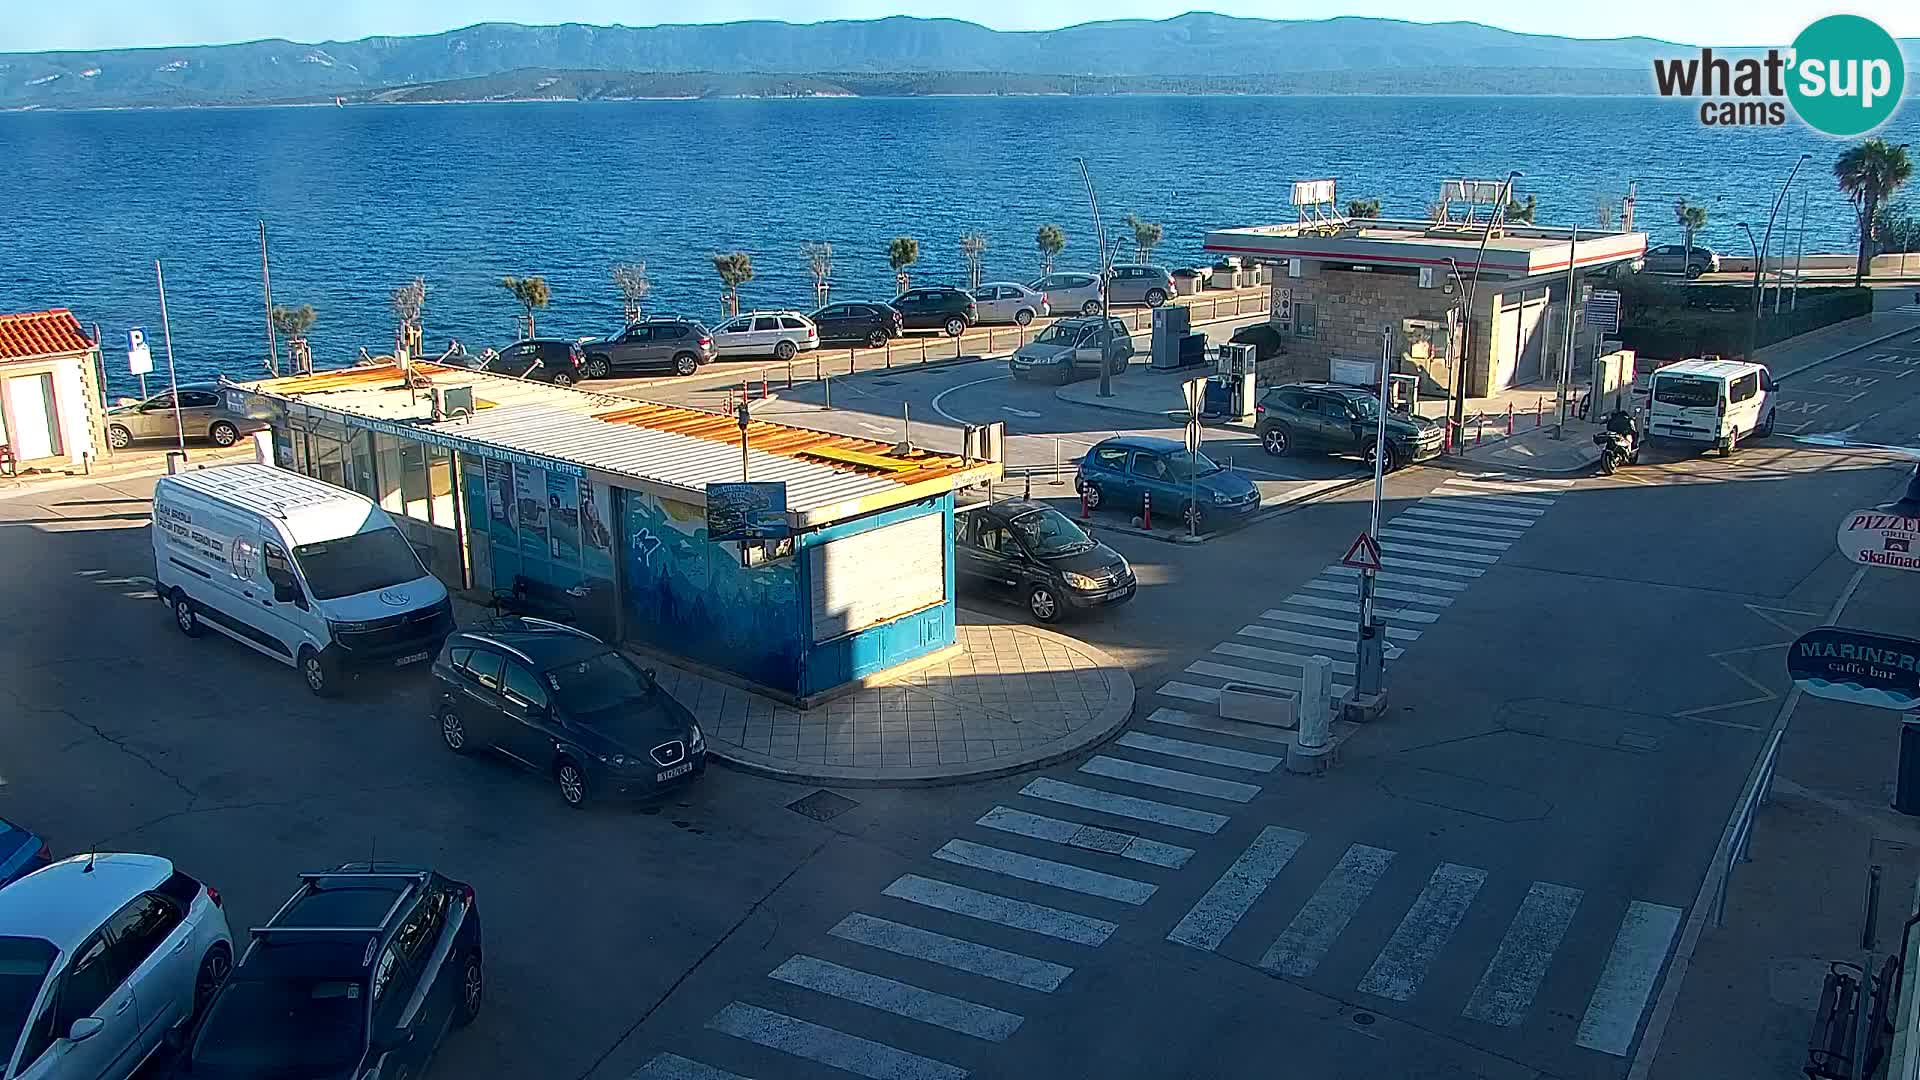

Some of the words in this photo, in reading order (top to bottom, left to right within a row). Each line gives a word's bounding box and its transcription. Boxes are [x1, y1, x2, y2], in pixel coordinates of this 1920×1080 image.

[1775, 400, 1831, 414] AXI
[396, 428, 437, 444] AUTOBUSNA
[437, 436, 469, 451] POSTAJA
[478, 446, 493, 457] BUS
[494, 450, 526, 464] STATION
[528, 456, 555, 471] TICKET
[556, 463, 583, 476] OFFICE
[1881, 530, 1916, 541] GRILL
[1828, 661, 1865, 675] caffe
[1870, 665, 1896, 680] bar
